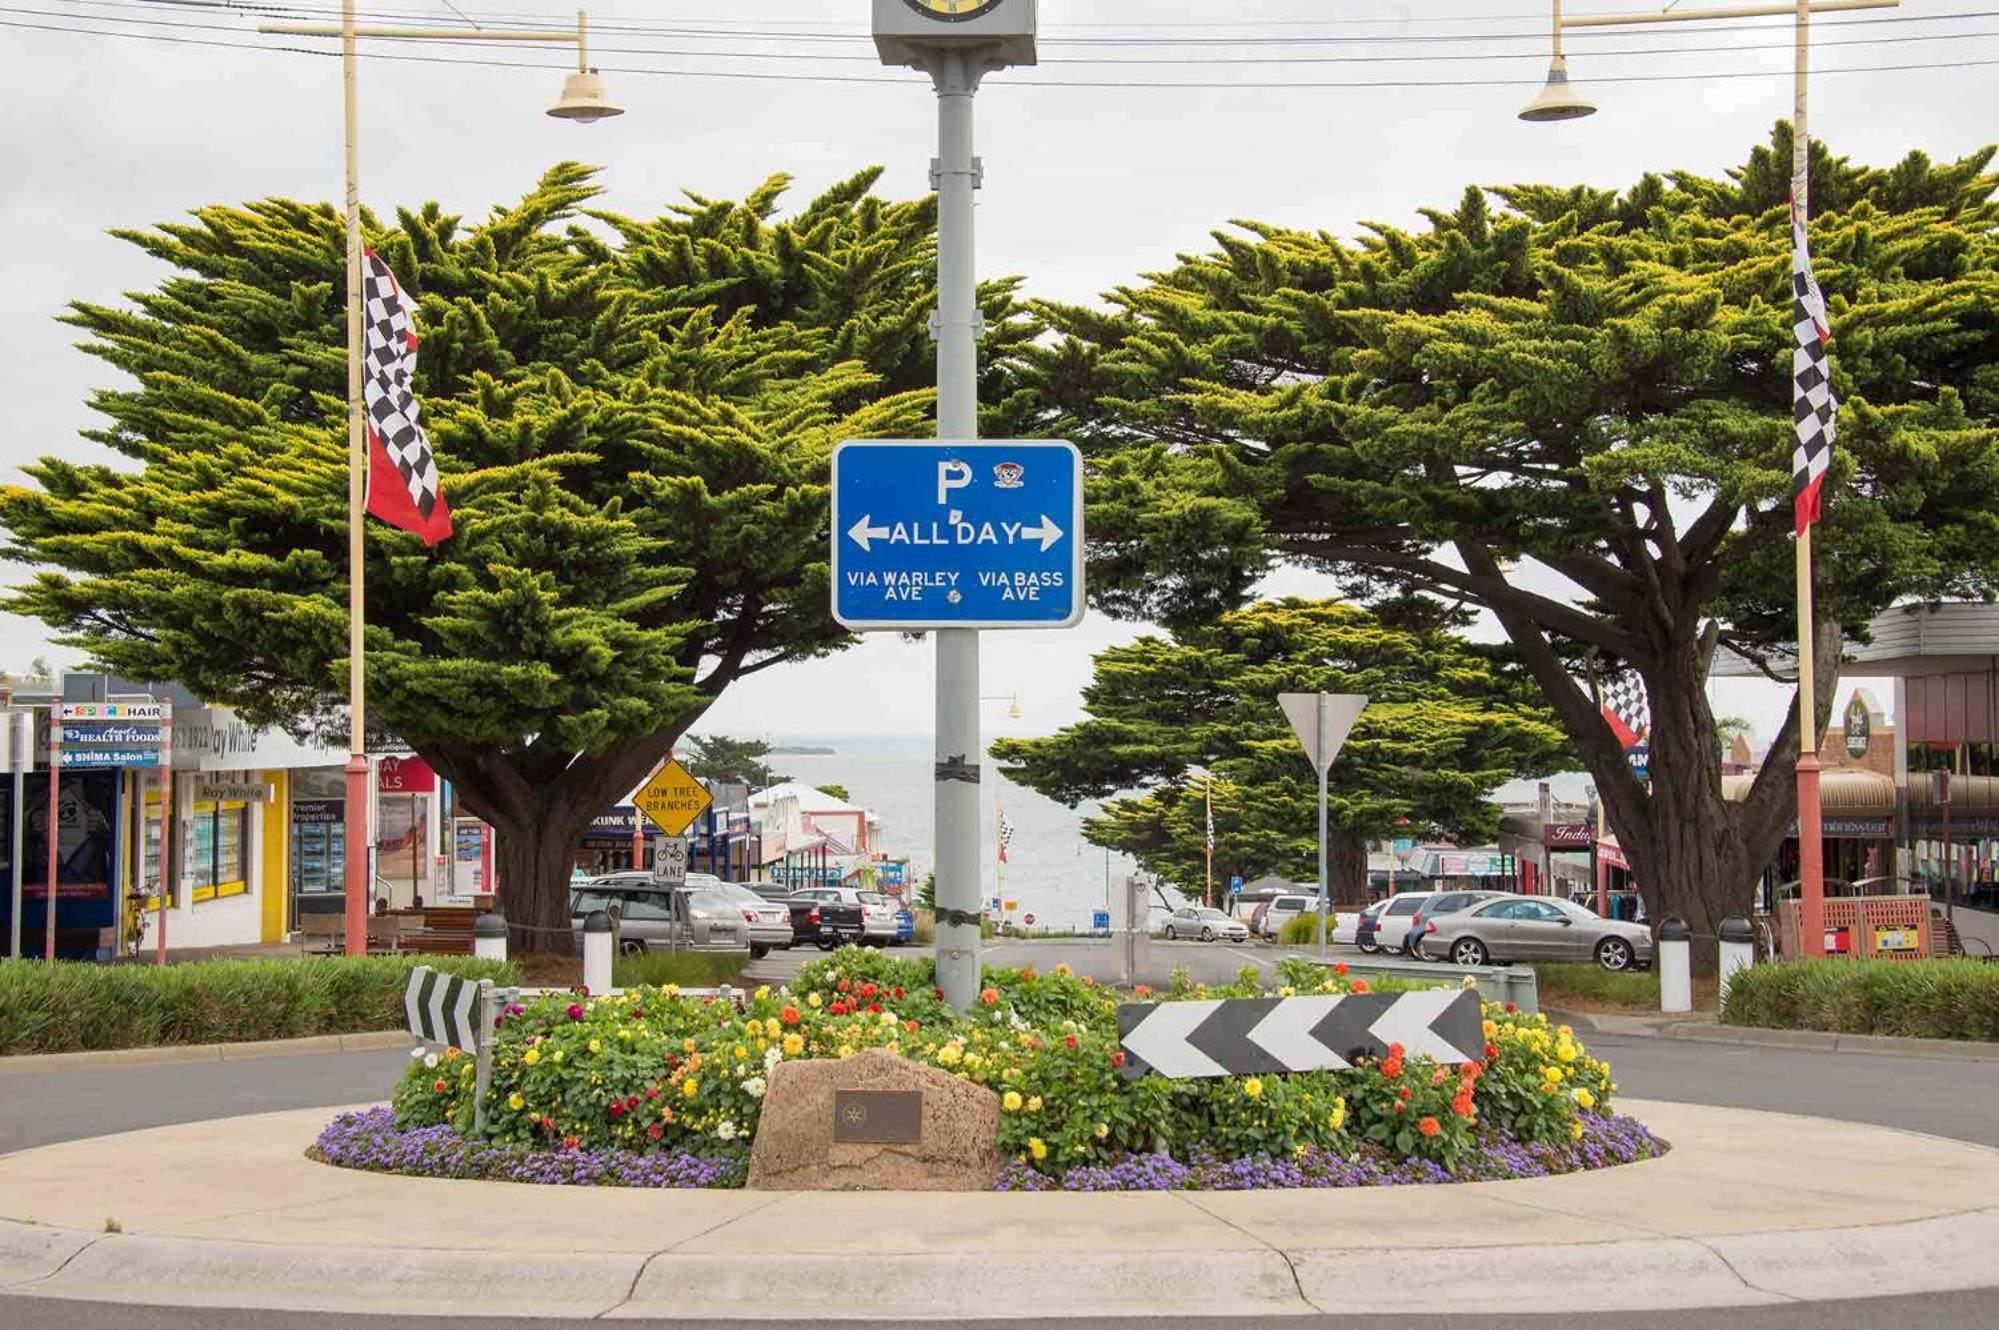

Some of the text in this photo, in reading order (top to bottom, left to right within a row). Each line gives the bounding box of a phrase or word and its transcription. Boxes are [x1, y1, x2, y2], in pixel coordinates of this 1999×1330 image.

[938, 461, 973, 504] P
[889, 522, 1022, 545] ALL DAY
[847, 572, 960, 586] VIA WARLEY
[978, 572, 1064, 586] VIA BASS
[885, 587, 922, 600] AVE
[1002, 587, 1040, 600] AVE
[127, 708, 160, 716] HAIR
[80, 733, 160, 742] HEALTH FOODS
[113, 752, 143, 761] Salon
[647, 786, 698, 798] LOW TREE
[646, 800, 700, 811] BRANCHES
[656, 866, 682, 877] LANE
